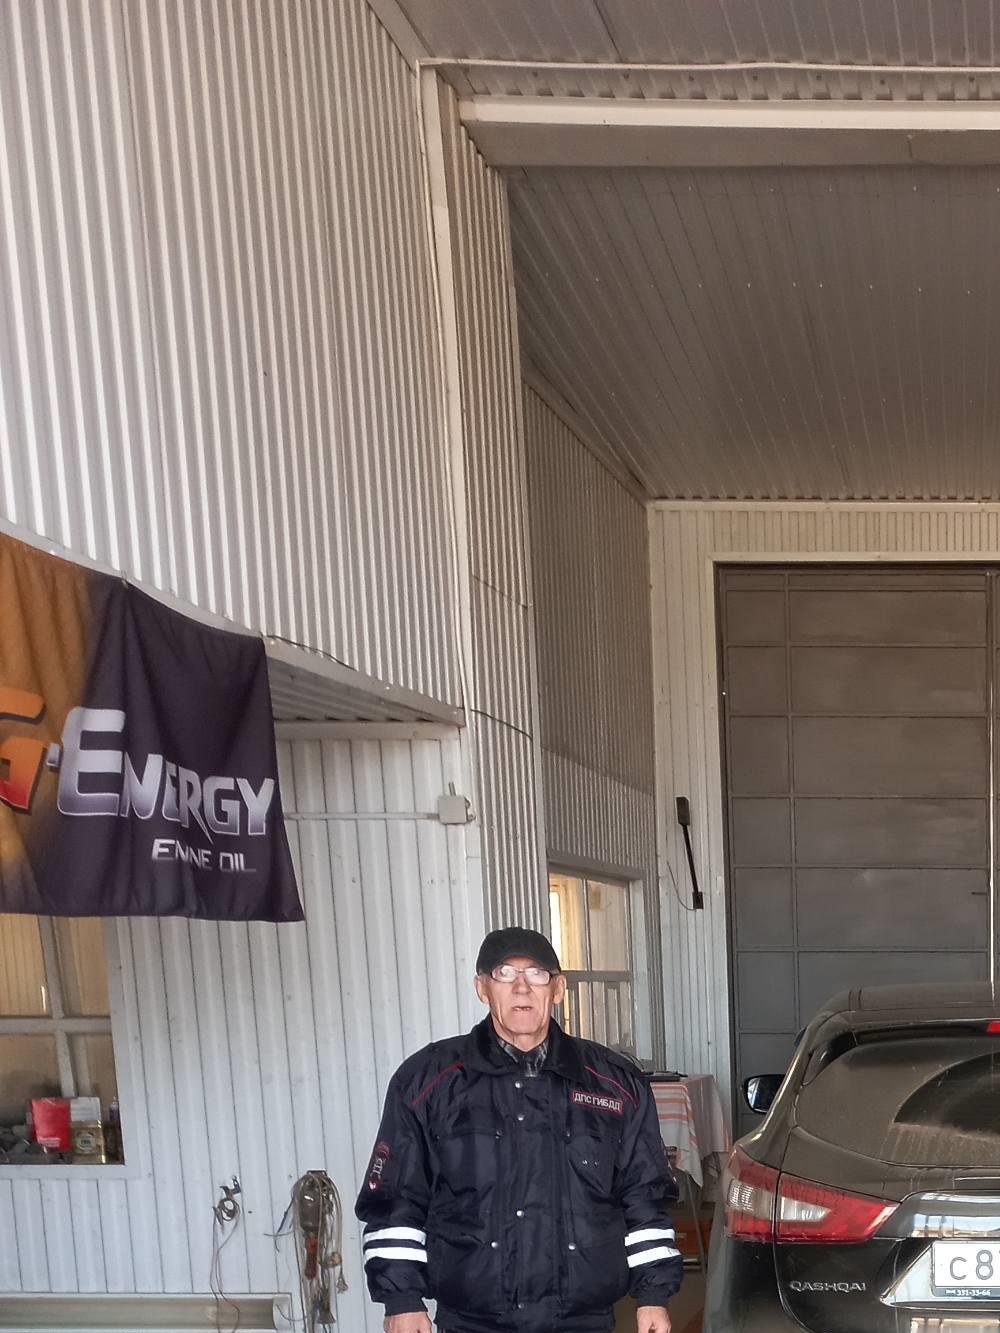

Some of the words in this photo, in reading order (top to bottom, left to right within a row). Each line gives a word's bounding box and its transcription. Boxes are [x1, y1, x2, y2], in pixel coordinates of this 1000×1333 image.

[219, 852, 256, 872] OIL
[575, 1092, 592, 1103] ДПС
[790, 1281, 866, 1293] QASHQAI
